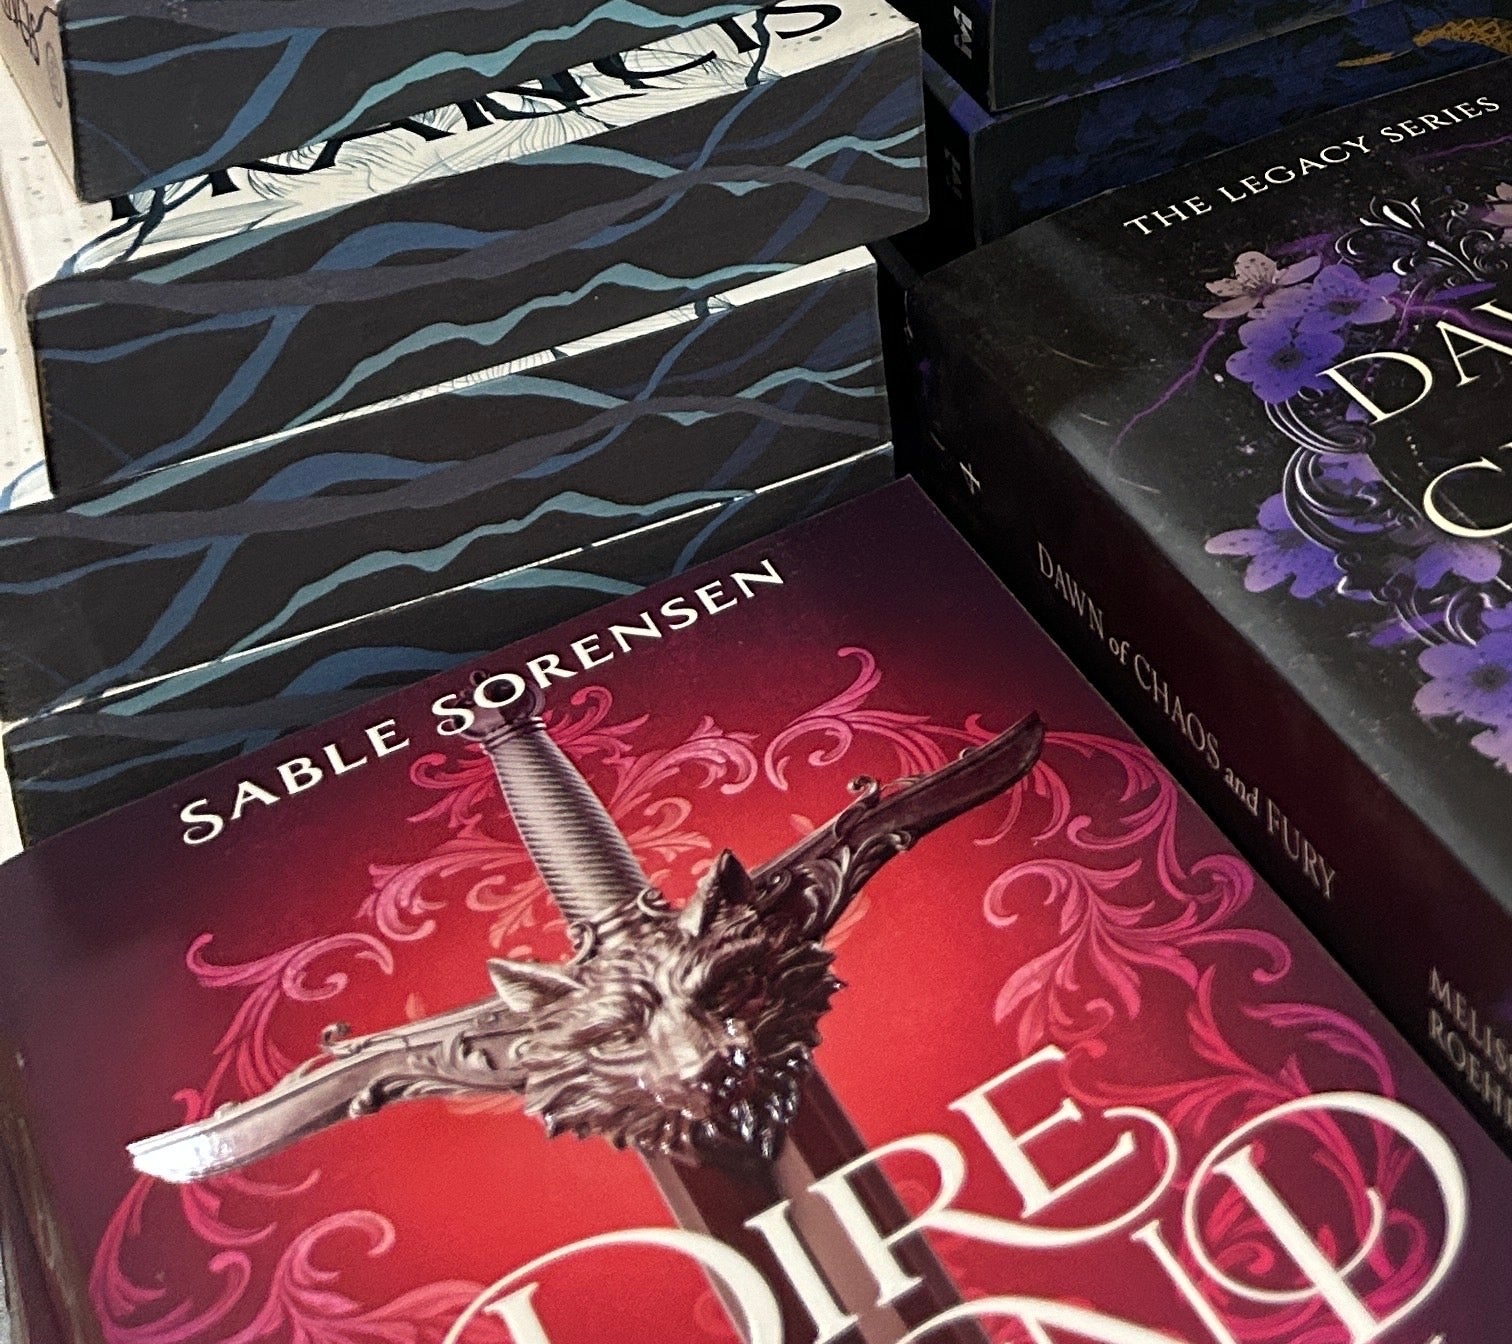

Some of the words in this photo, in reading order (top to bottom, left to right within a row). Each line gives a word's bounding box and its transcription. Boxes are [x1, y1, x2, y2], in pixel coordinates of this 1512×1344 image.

[1125, 192, 1212, 238] THE
[1219, 132, 1374, 206] LEGACY
[1380, 95, 1502, 151] SERIES
[179, 717, 411, 848] SABLE
[431, 558, 785, 737] SORENSEN
[1035, 540, 1107, 649] DAWN
[1107, 633, 1132, 669] of
[1131, 652, 1223, 778] CHAOS
[1224, 764, 1260, 816] and
[1264, 797, 1336, 900] FURY
